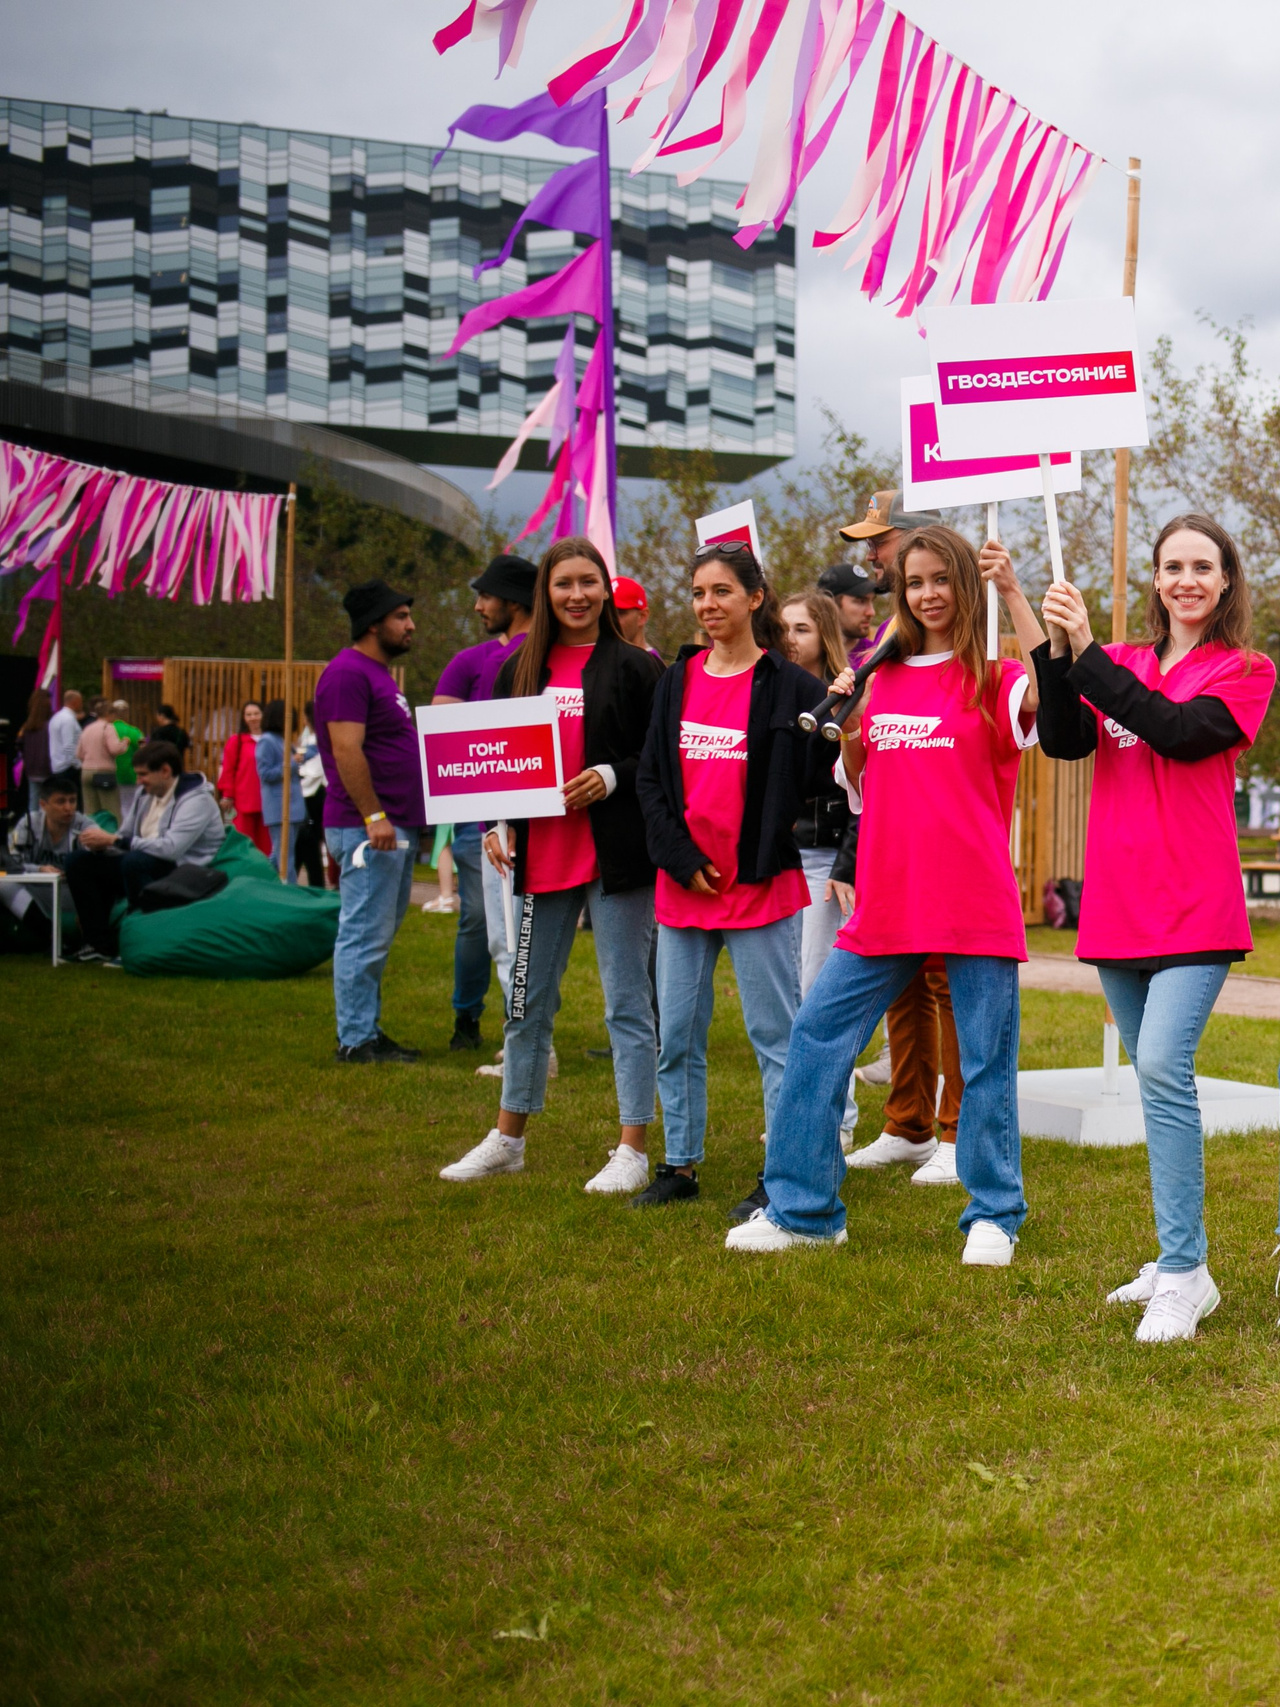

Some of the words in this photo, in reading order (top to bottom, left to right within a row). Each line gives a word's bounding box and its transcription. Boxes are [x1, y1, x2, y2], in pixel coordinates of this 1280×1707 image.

[947, 364, 1127, 390] ГВОЗДЕСТОЯНИЕ
[680, 733, 733, 746] СТРАНА
[871, 723, 929, 739] СТРАНА
[468, 741, 508, 758] ГОНГ
[876, 739, 901, 752] БЕЗ
[904, 737, 955, 750] ГРАНИЦ
[685, 749, 710, 760] БЕЗ
[711, 750, 748, 761] ГРАНИ
[437, 756, 543, 778] МЕДИТАЦИЯ
[519, 917, 533, 948] KLEIN
[515, 949, 529, 986] CALVIN
[512, 987, 526, 1020] JEANS
